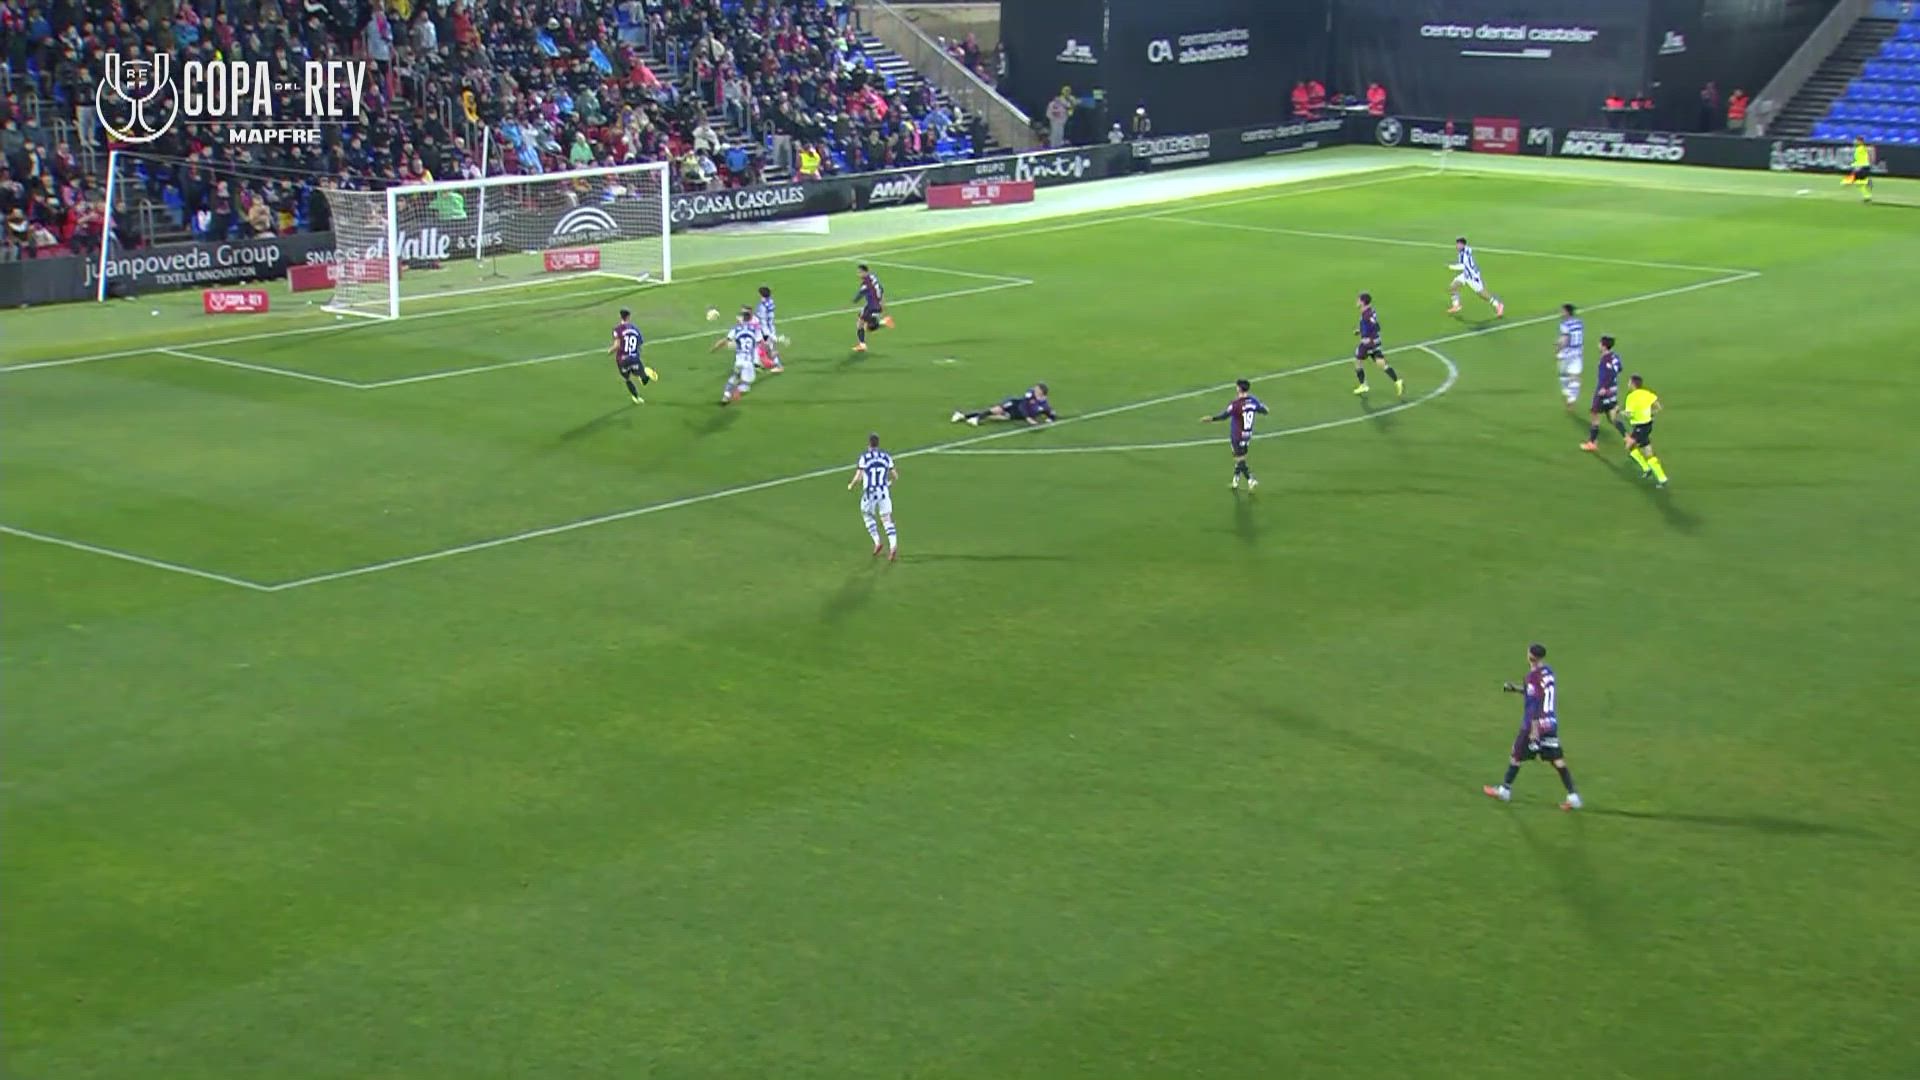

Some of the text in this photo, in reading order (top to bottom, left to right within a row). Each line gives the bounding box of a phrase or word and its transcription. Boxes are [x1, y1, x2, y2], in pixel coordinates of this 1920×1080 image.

[1421, 24, 1473, 39] centro
[1475, 25, 1527, 41] dental
[1560, 140, 1686, 161] MOLINERO
[693, 197, 733, 215] CASA
[735, 186, 805, 209] CASCALES
[84, 244, 281, 287] juanpoveda Group
[155, 265, 257, 285] TEXTILE INNOVATION
[623, 335, 638, 353] 19
[869, 466, 886, 486] 17
